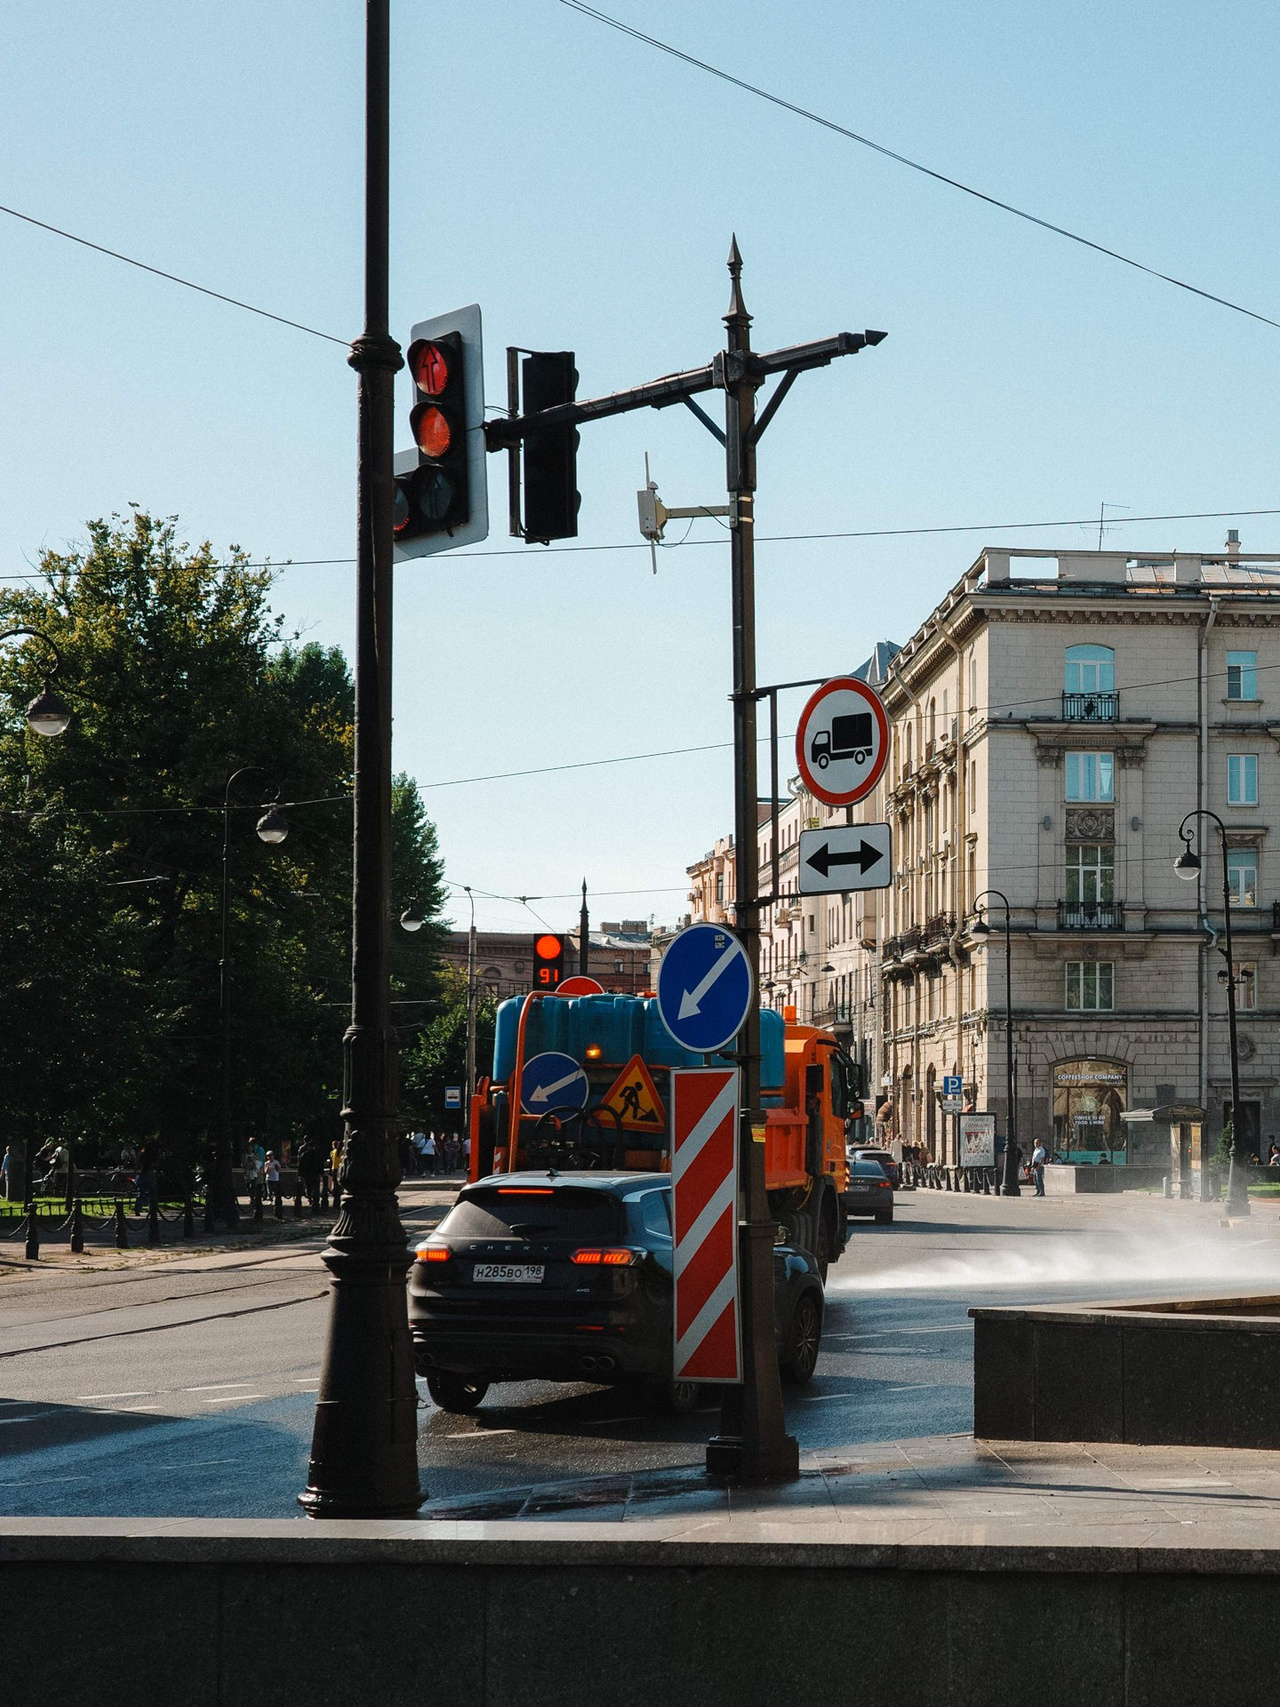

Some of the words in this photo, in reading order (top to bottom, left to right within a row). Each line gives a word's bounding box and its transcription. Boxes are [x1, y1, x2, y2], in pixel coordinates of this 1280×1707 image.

[540, 968, 559, 983] 91
[476, 1265, 522, 1278] Н285ВО
[524, 1266, 542, 1276] 198
